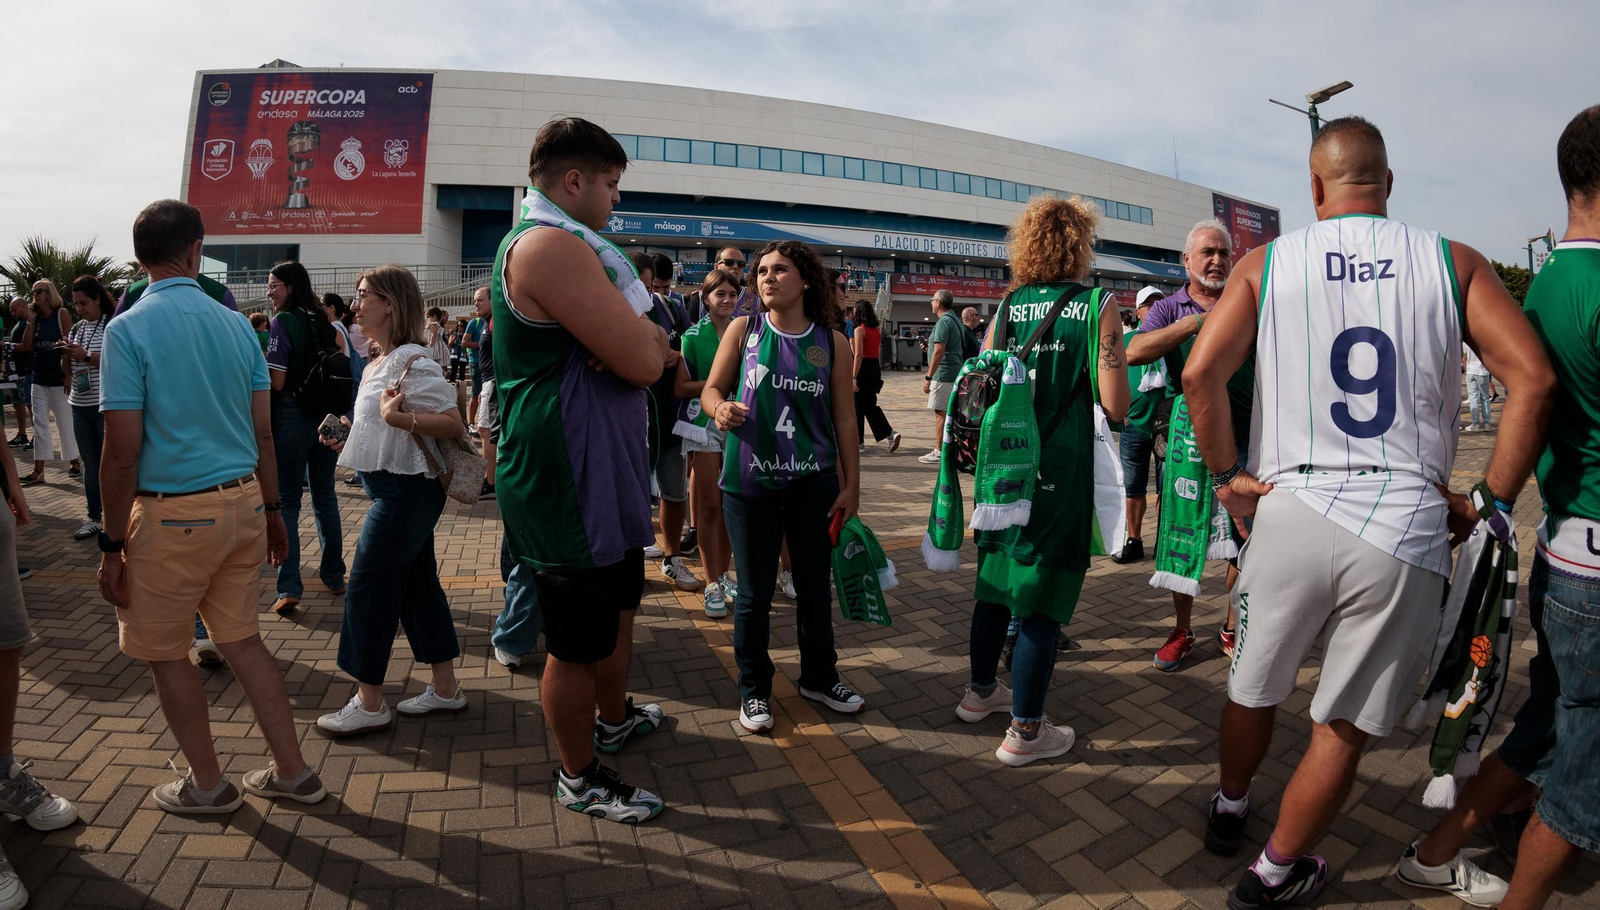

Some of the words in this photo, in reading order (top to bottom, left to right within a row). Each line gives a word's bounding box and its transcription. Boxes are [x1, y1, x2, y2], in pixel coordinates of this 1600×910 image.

[397, 85, 418, 94] acb
[259, 89, 366, 106] SUPERCOPA
[257, 109, 298, 119] endesa
[307, 108, 342, 118] MÁLAGA
[343, 110, 365, 118] 2025
[281, 211, 311, 219] endesa
[1235, 207, 1261, 219] BIENVENIDOS
[654, 221, 686, 232] málaga
[1236, 216, 1262, 229] SUPERCOPA
[874, 234, 919, 250] PALACIO
[923, 238, 936, 252] DE
[940, 240, 988, 257] DEPORTES
[993, 245, 1008, 259] JOS
[916, 264, 924, 273] B1
[1325, 251, 1396, 283] Díaz
[990, 269, 999, 279] B2
[962, 279, 985, 287] endesa
[1330, 326, 1397, 439] 9
[775, 405, 796, 440] 4
[749, 452, 821, 474] Andalucía
